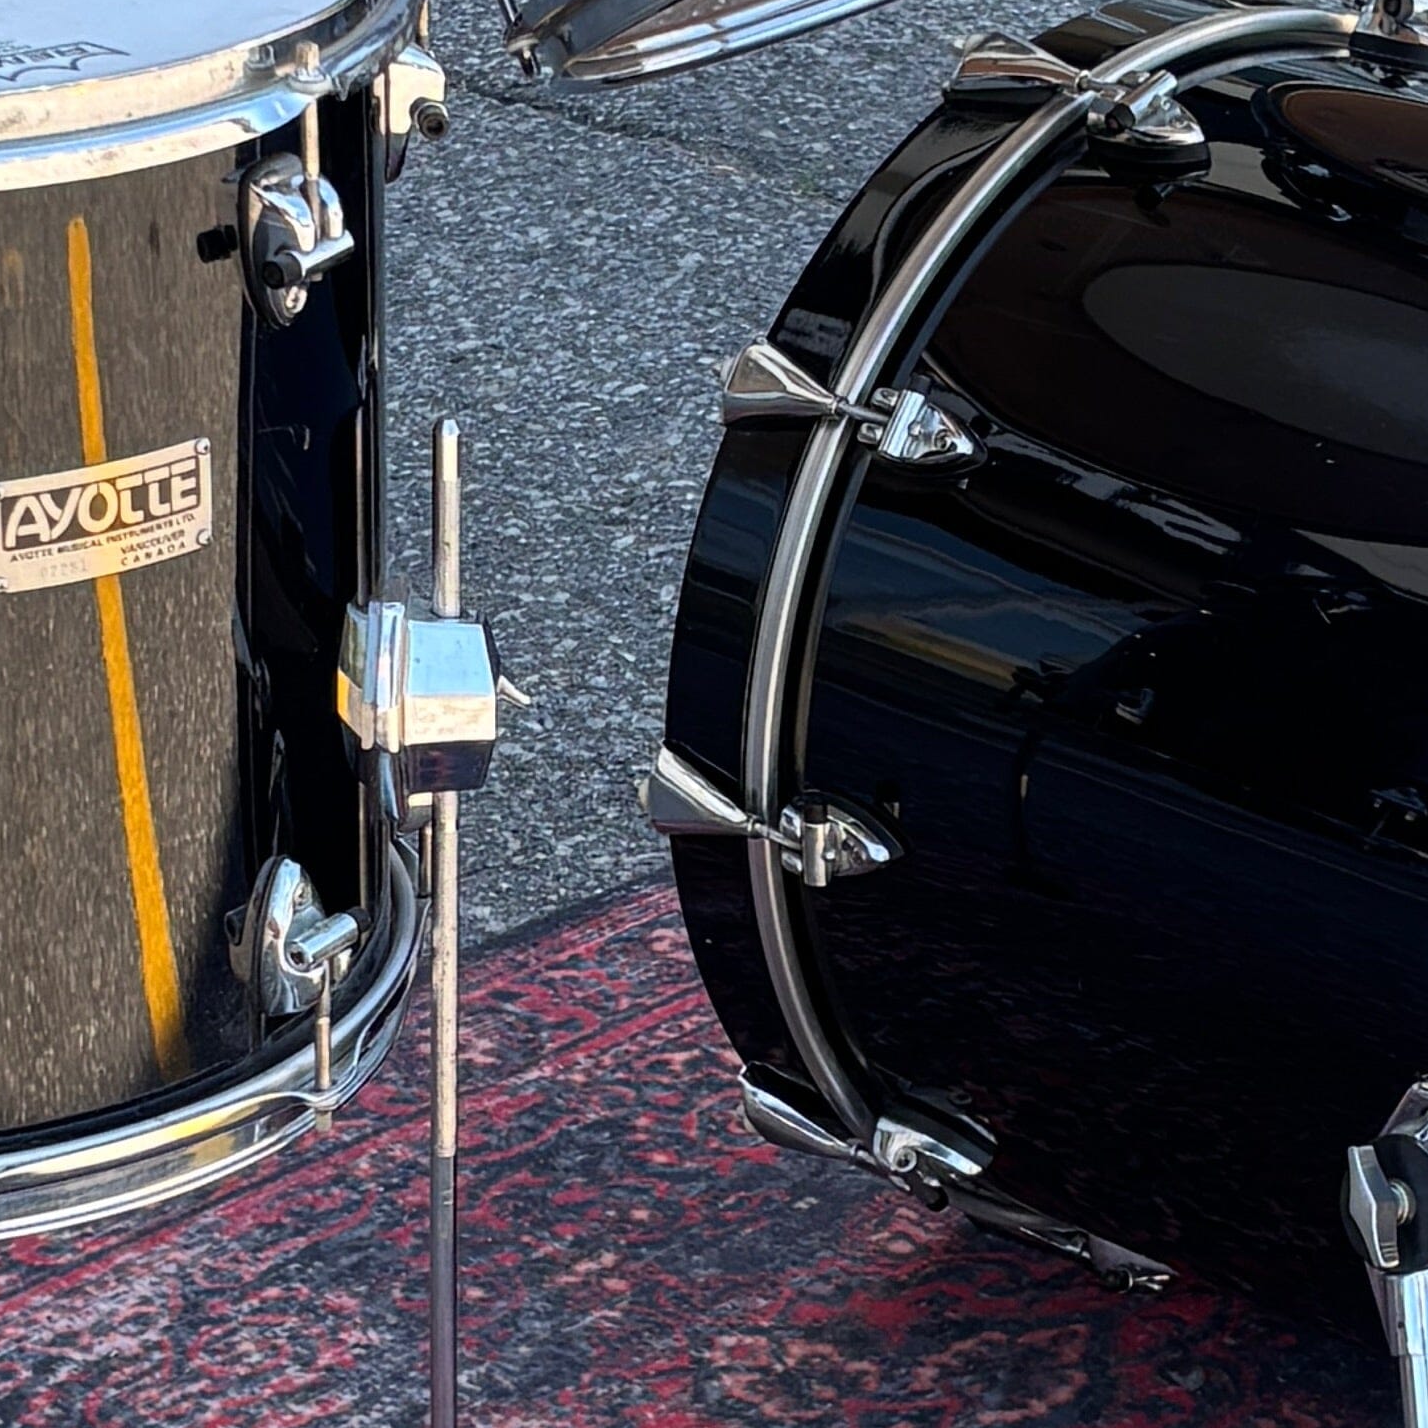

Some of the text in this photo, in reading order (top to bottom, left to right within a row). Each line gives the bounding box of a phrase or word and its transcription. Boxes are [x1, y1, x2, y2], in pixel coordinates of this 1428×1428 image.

[5, 458, 197, 549] AYOTTE
[120, 529, 185, 555] VANCOUVER
[120, 541, 186, 566] CANADA
[10, 547, 54, 563] AYOTTE
